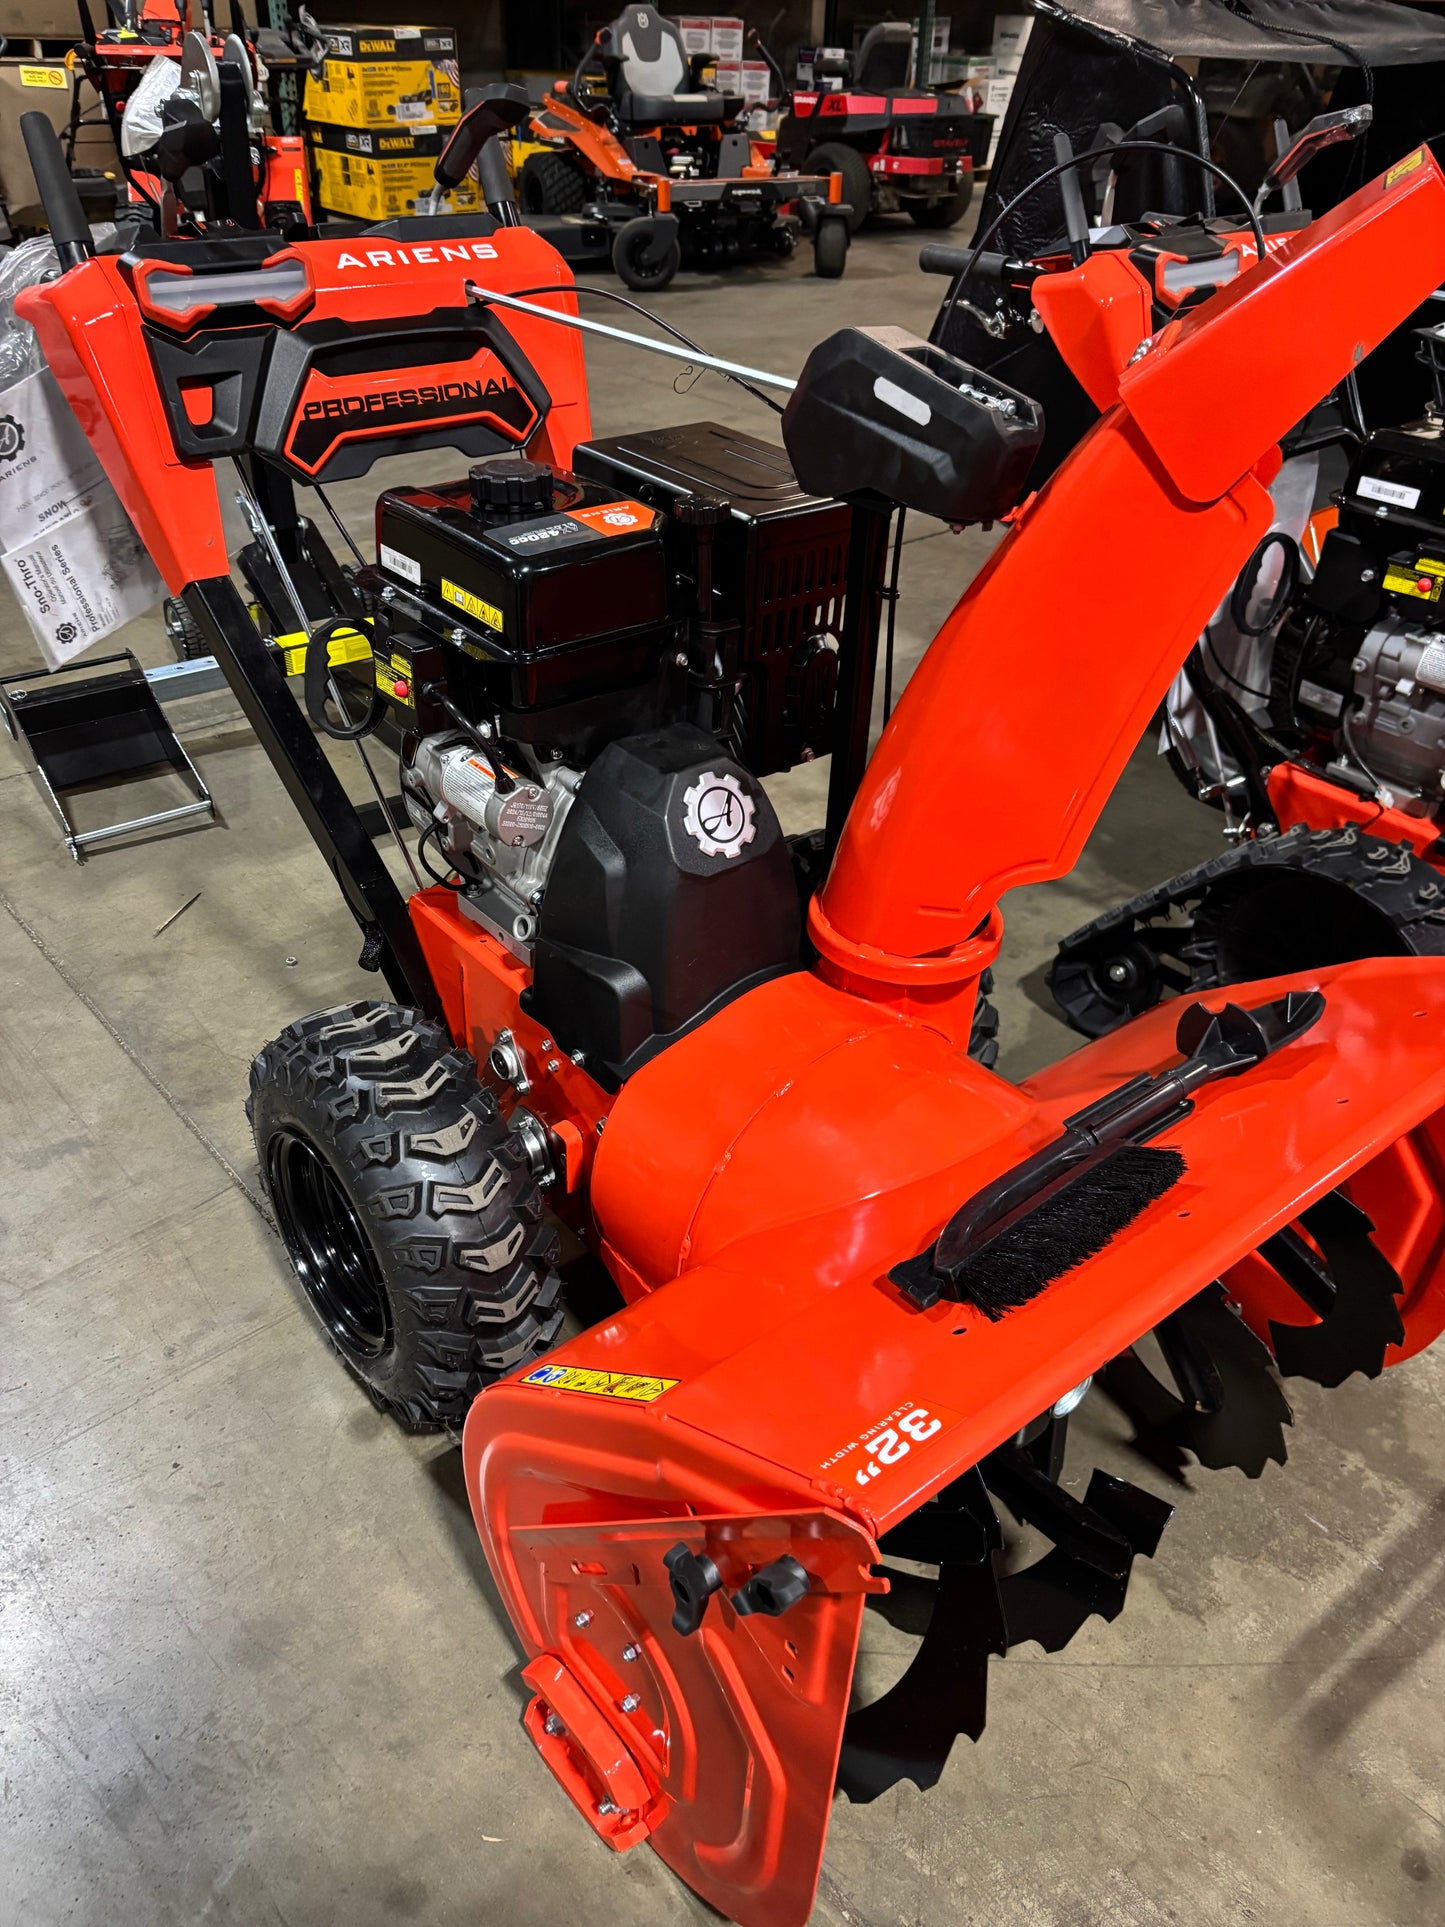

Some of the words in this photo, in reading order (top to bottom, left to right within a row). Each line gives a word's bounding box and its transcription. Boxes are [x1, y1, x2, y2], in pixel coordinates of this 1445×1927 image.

[336, 243, 499, 270] ARIENS
[303, 376, 517, 421] PROFESSIONAL
[51, 543, 71, 576] Series
[66, 575, 101, 633] Professional
[859, 1401, 915, 1440] CLEARING
[820, 1441, 860, 1470] WIDTH
